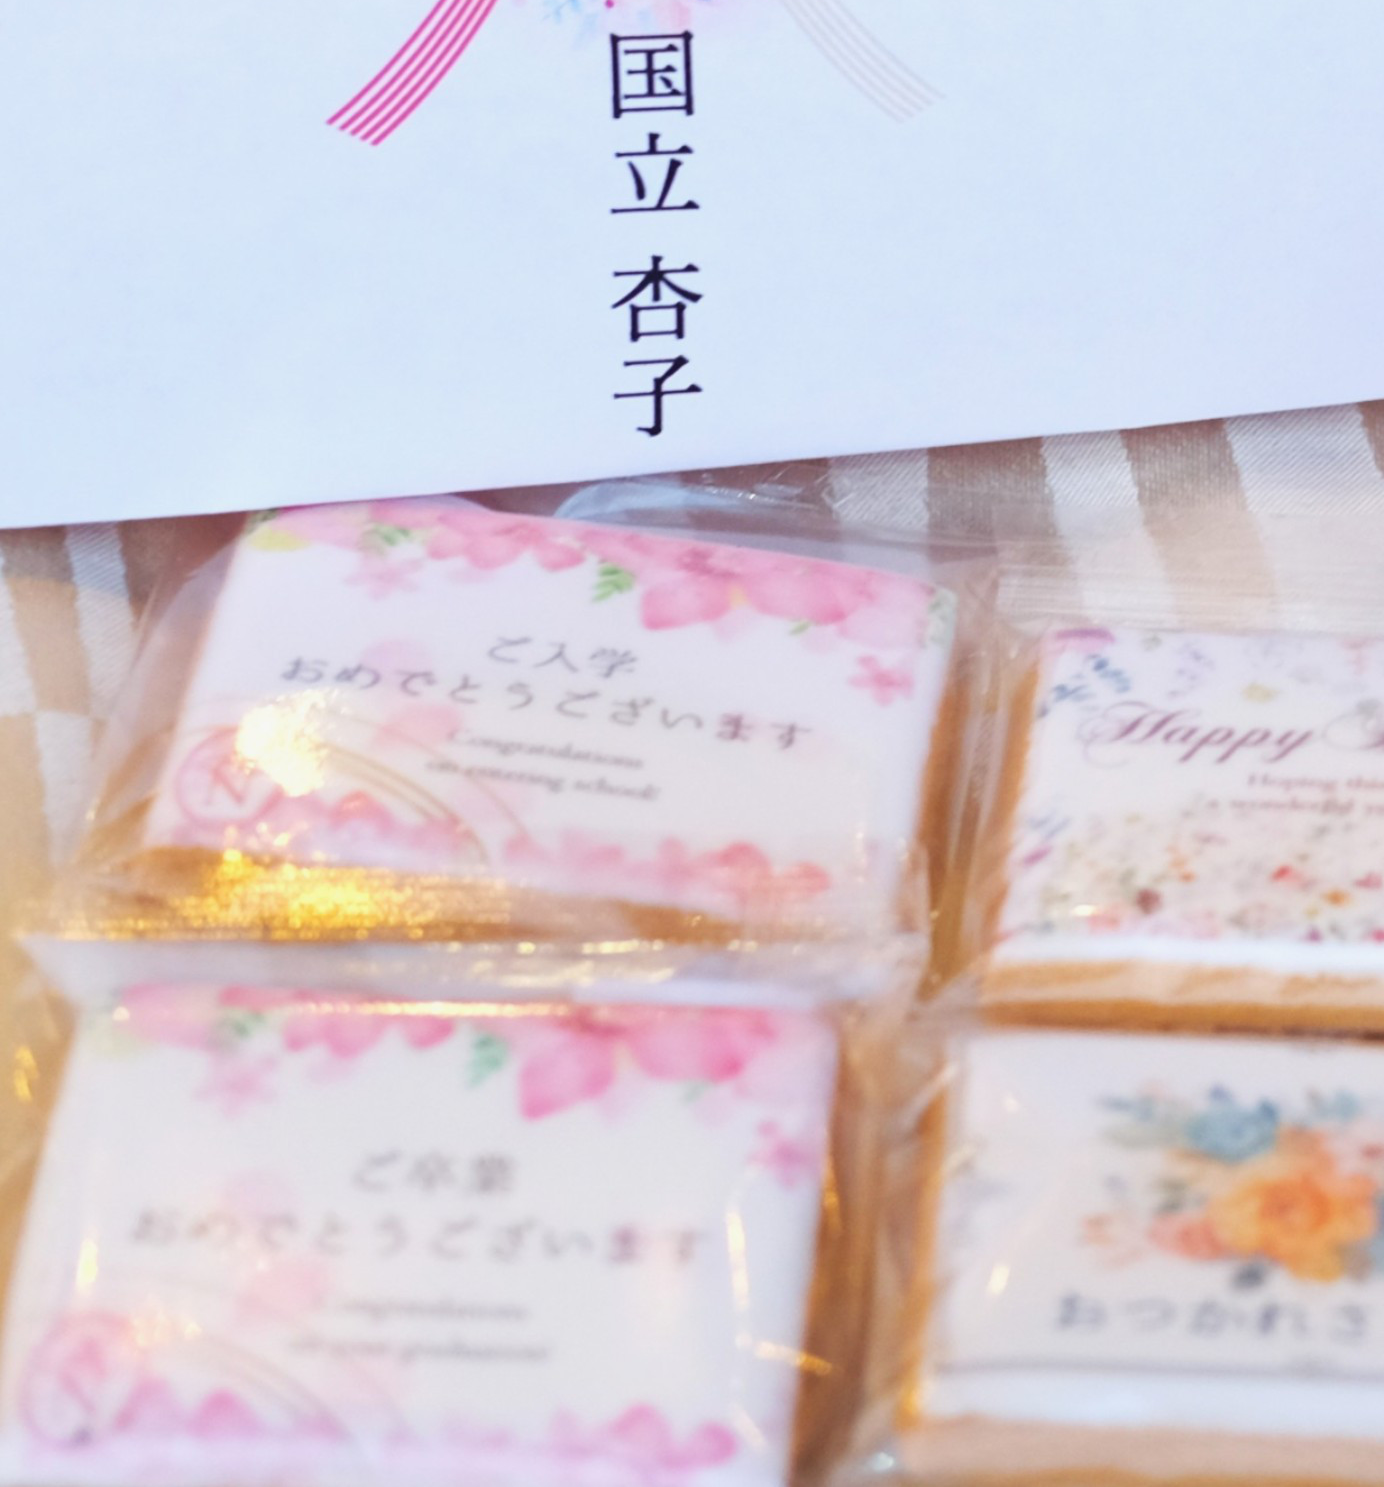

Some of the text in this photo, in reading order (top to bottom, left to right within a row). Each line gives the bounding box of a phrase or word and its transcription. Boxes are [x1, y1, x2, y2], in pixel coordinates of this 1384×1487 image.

[610, 29, 704, 437] 国立 杏子
[486, 634, 642, 680] ご入学
[280, 656, 813, 753] おめでとうございます
[1078, 702, 1314, 769] Happy
